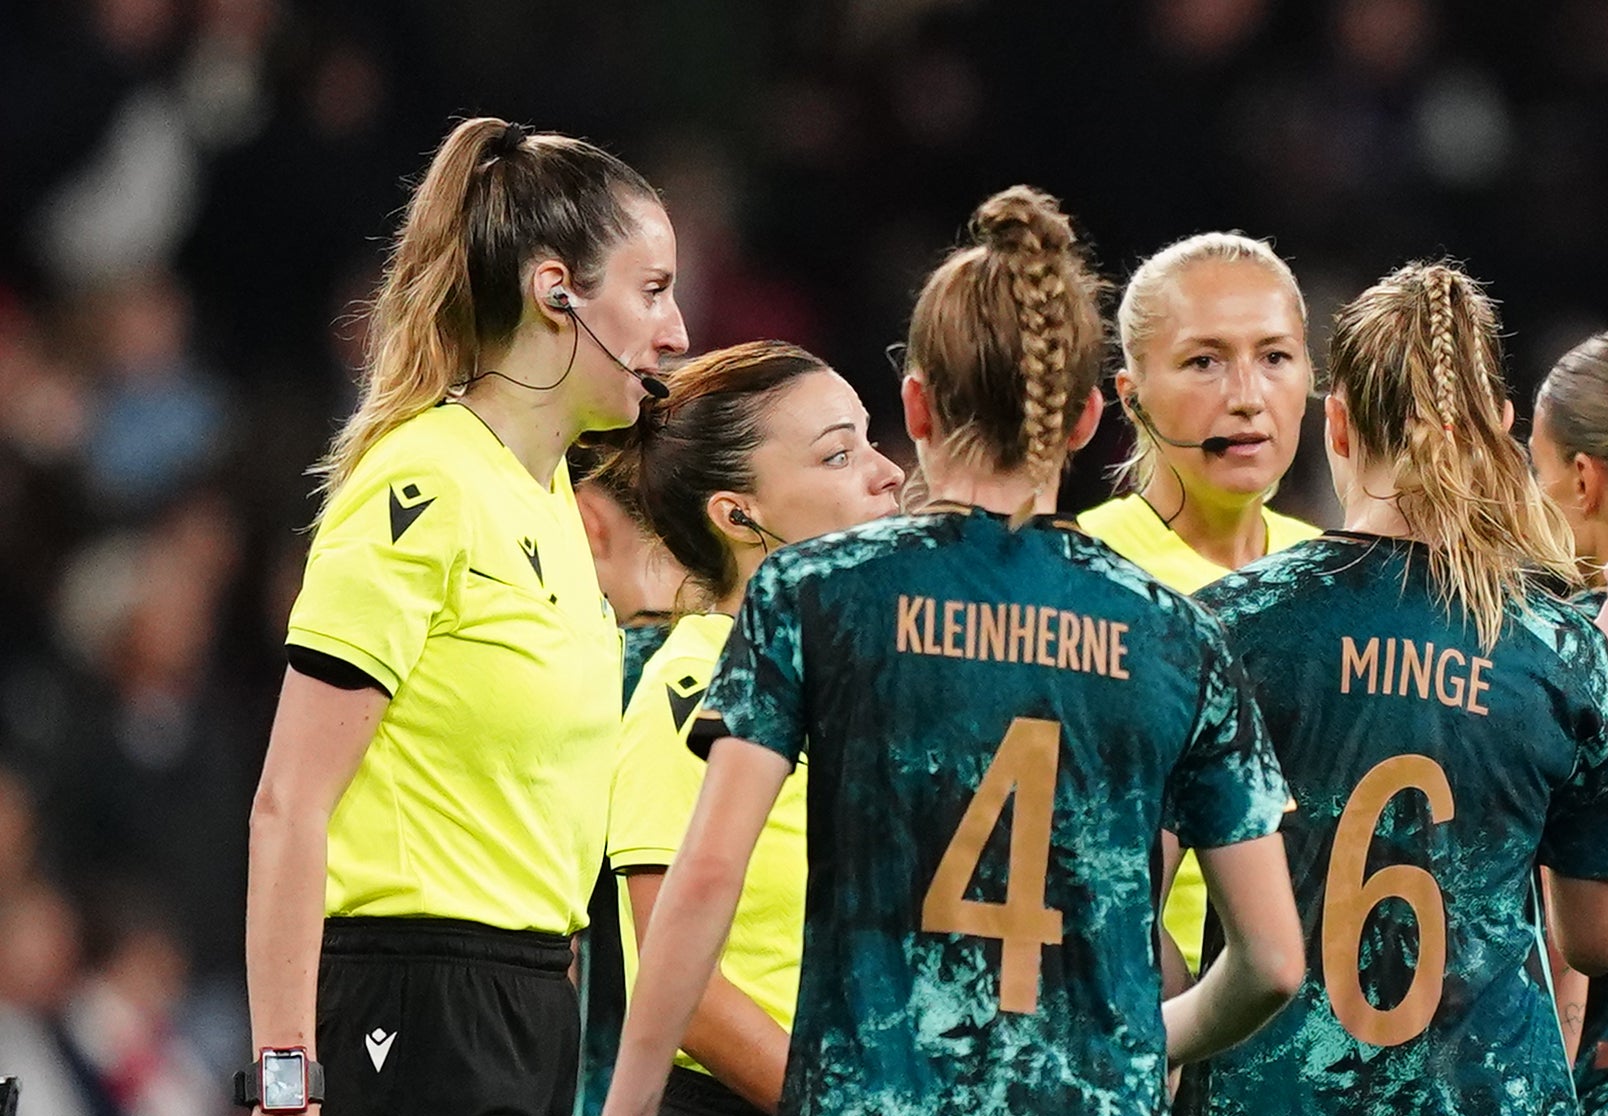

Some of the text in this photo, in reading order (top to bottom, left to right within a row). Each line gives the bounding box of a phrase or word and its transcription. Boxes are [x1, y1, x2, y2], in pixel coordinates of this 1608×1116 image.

[896, 595, 1130, 680] KLEINHERNE
[1340, 636, 1493, 716] MINGE
[921, 717, 1063, 1014] 4
[1322, 753, 1455, 1047] 6
